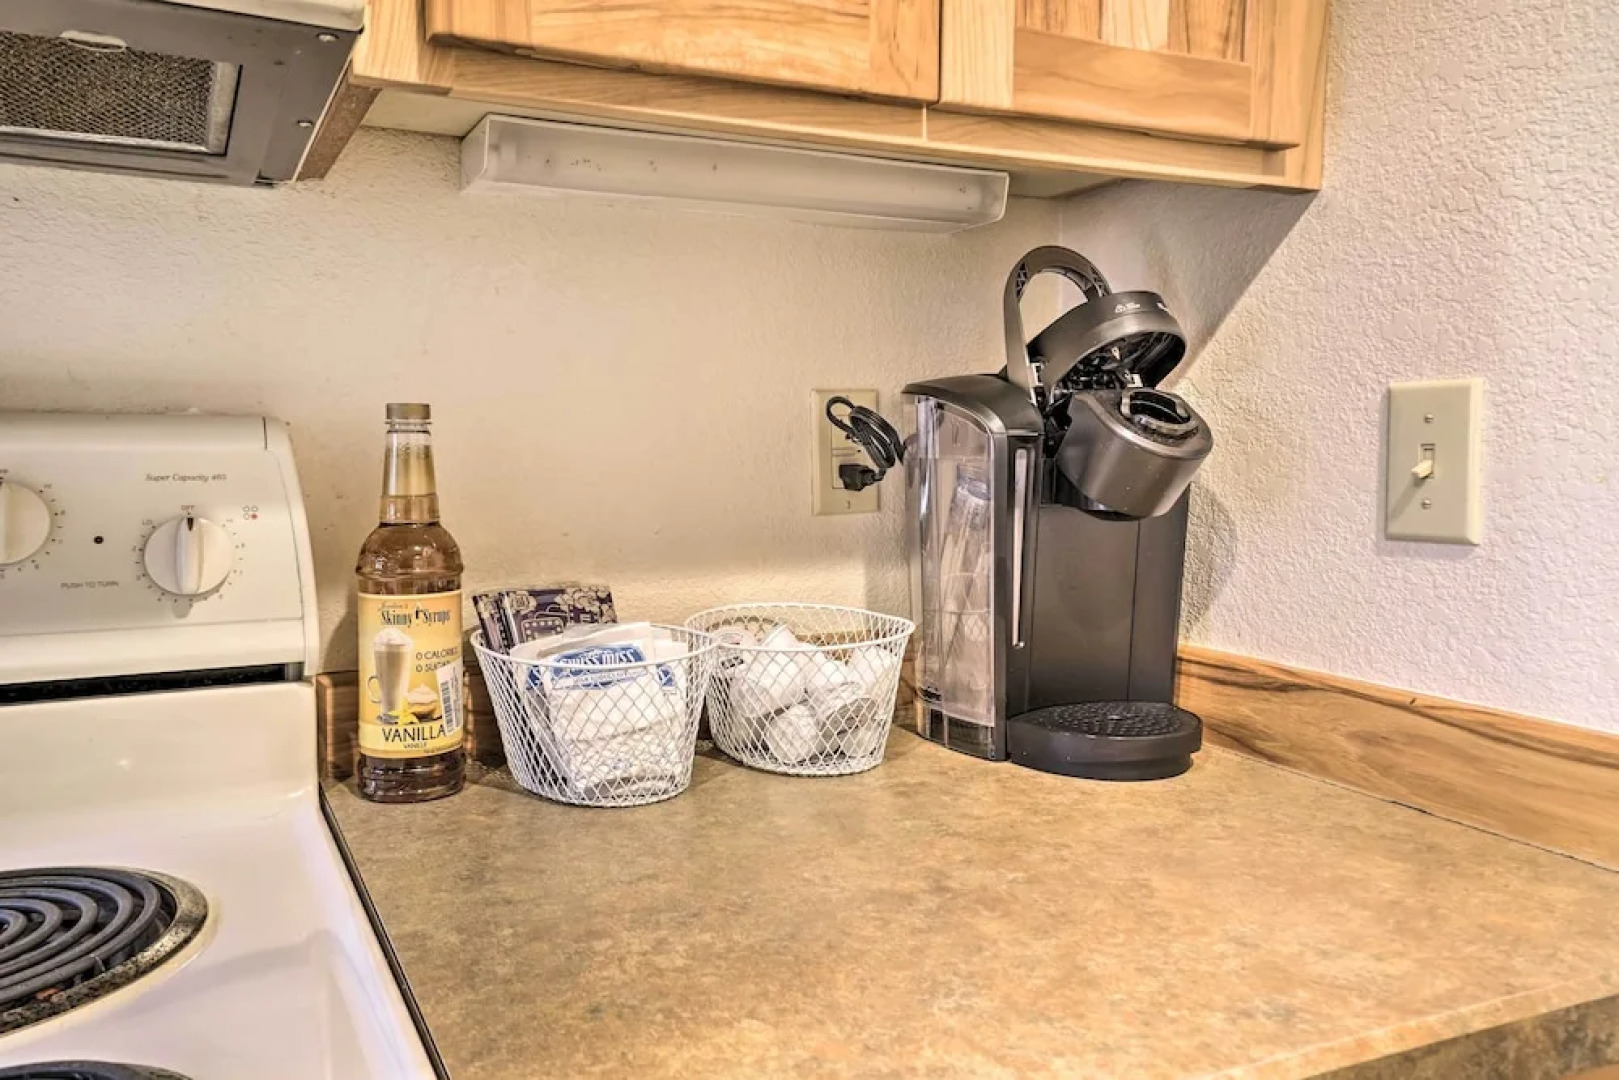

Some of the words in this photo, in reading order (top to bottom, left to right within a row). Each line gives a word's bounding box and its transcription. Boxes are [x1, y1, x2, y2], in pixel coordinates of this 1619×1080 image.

[145, 473, 170, 482] Super
[172, 473, 209, 483] Capacity
[97, 580, 119, 588] TURN
[381, 610, 412, 628] Skinny
[381, 725, 446, 742] VANILLA
